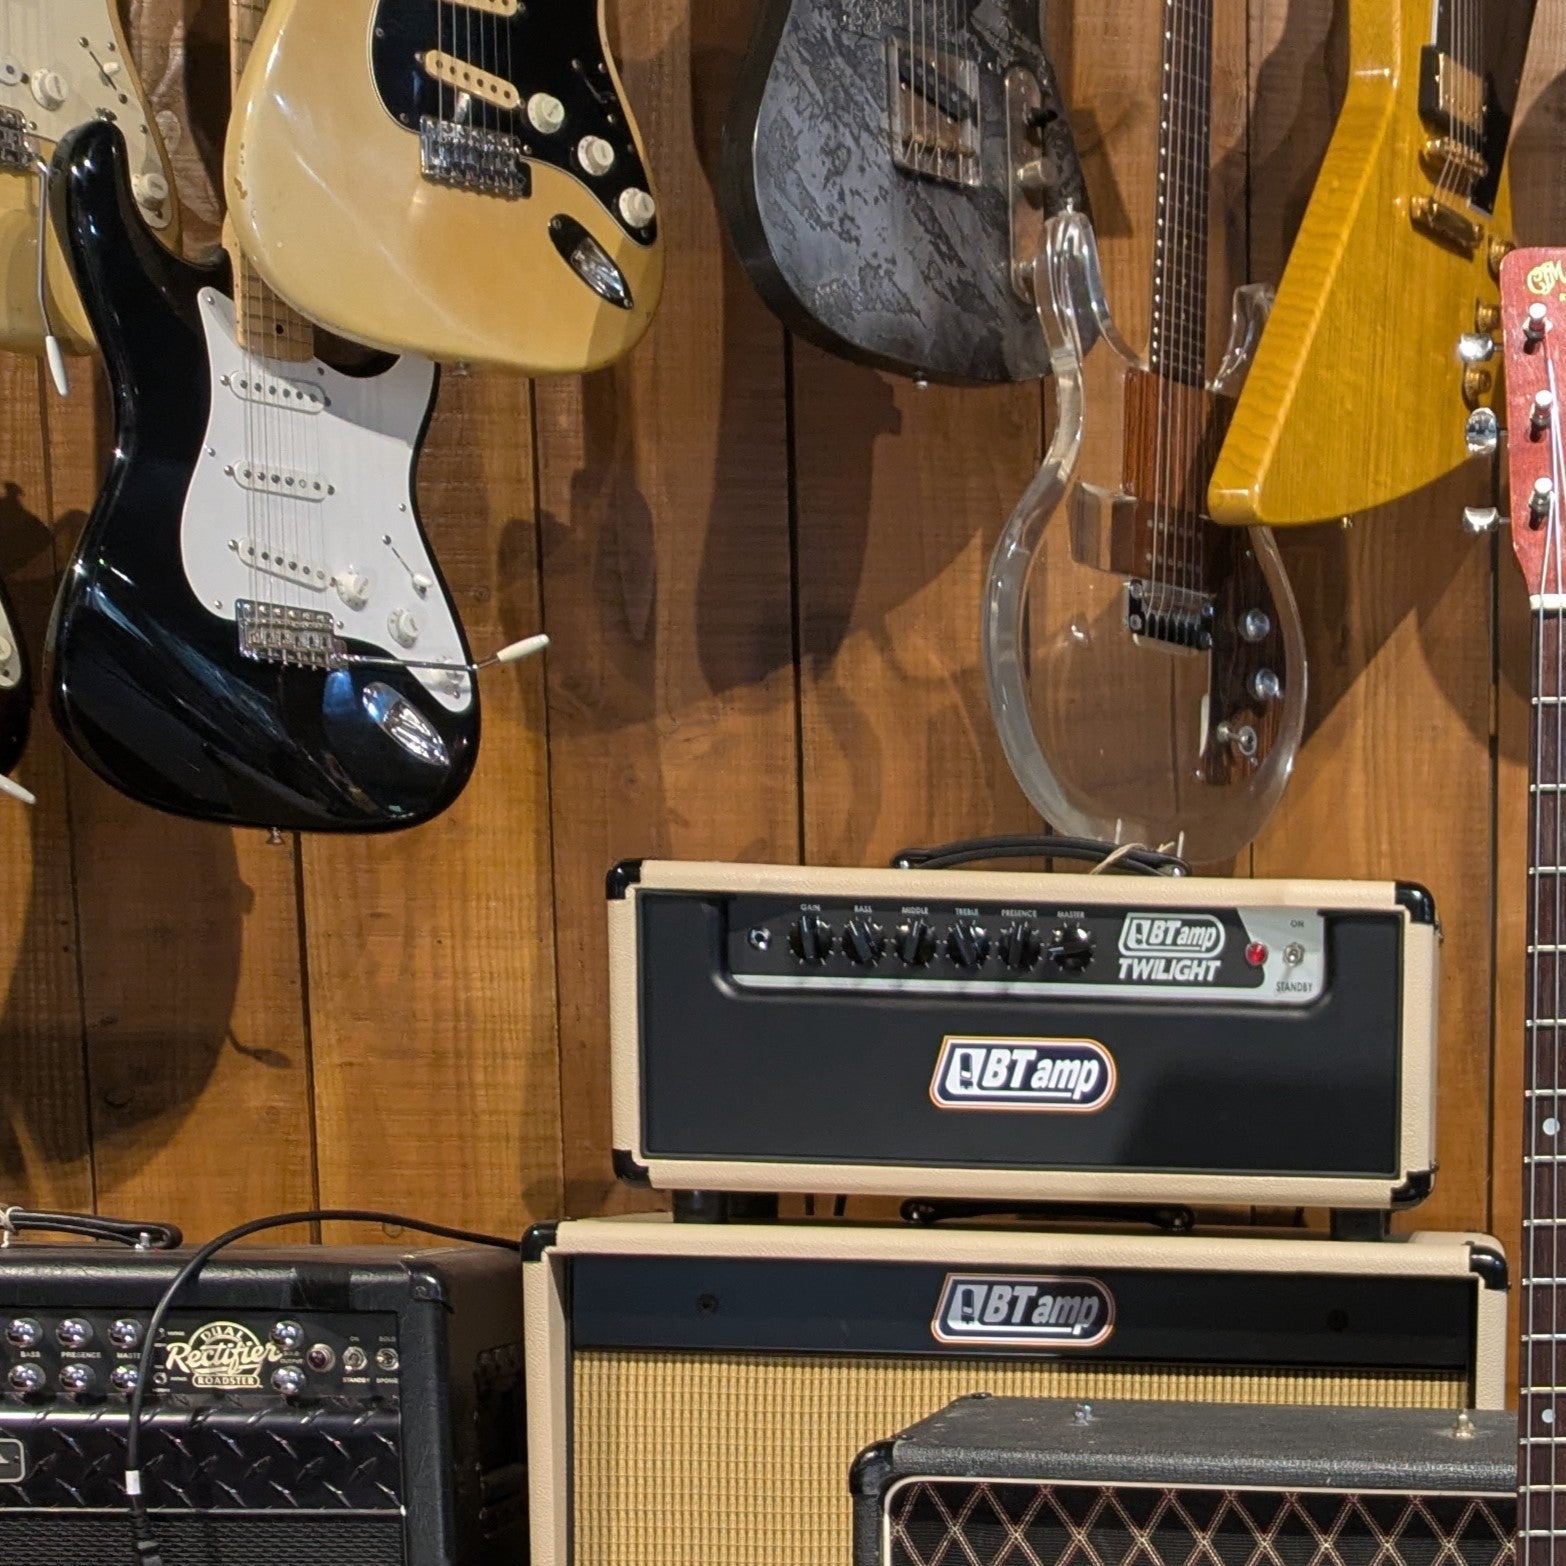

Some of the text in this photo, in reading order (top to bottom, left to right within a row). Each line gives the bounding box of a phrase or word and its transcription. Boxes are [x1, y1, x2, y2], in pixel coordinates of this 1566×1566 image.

[800, 903, 1085, 919] GAIN BASS MIDDLE TREBLE PRESENCE MASTER
[1289, 919, 1305, 929] ON
[1118, 957, 1222, 982] TWILIGHT
[1276, 981, 1313, 993] STANDBY
[199, 1325, 245, 1341] DUAL
[60, 1351, 102, 1359] PRESENCE
[165, 1340, 283, 1375] Rectifier
[197, 1375, 255, 1386] ROADSTER
